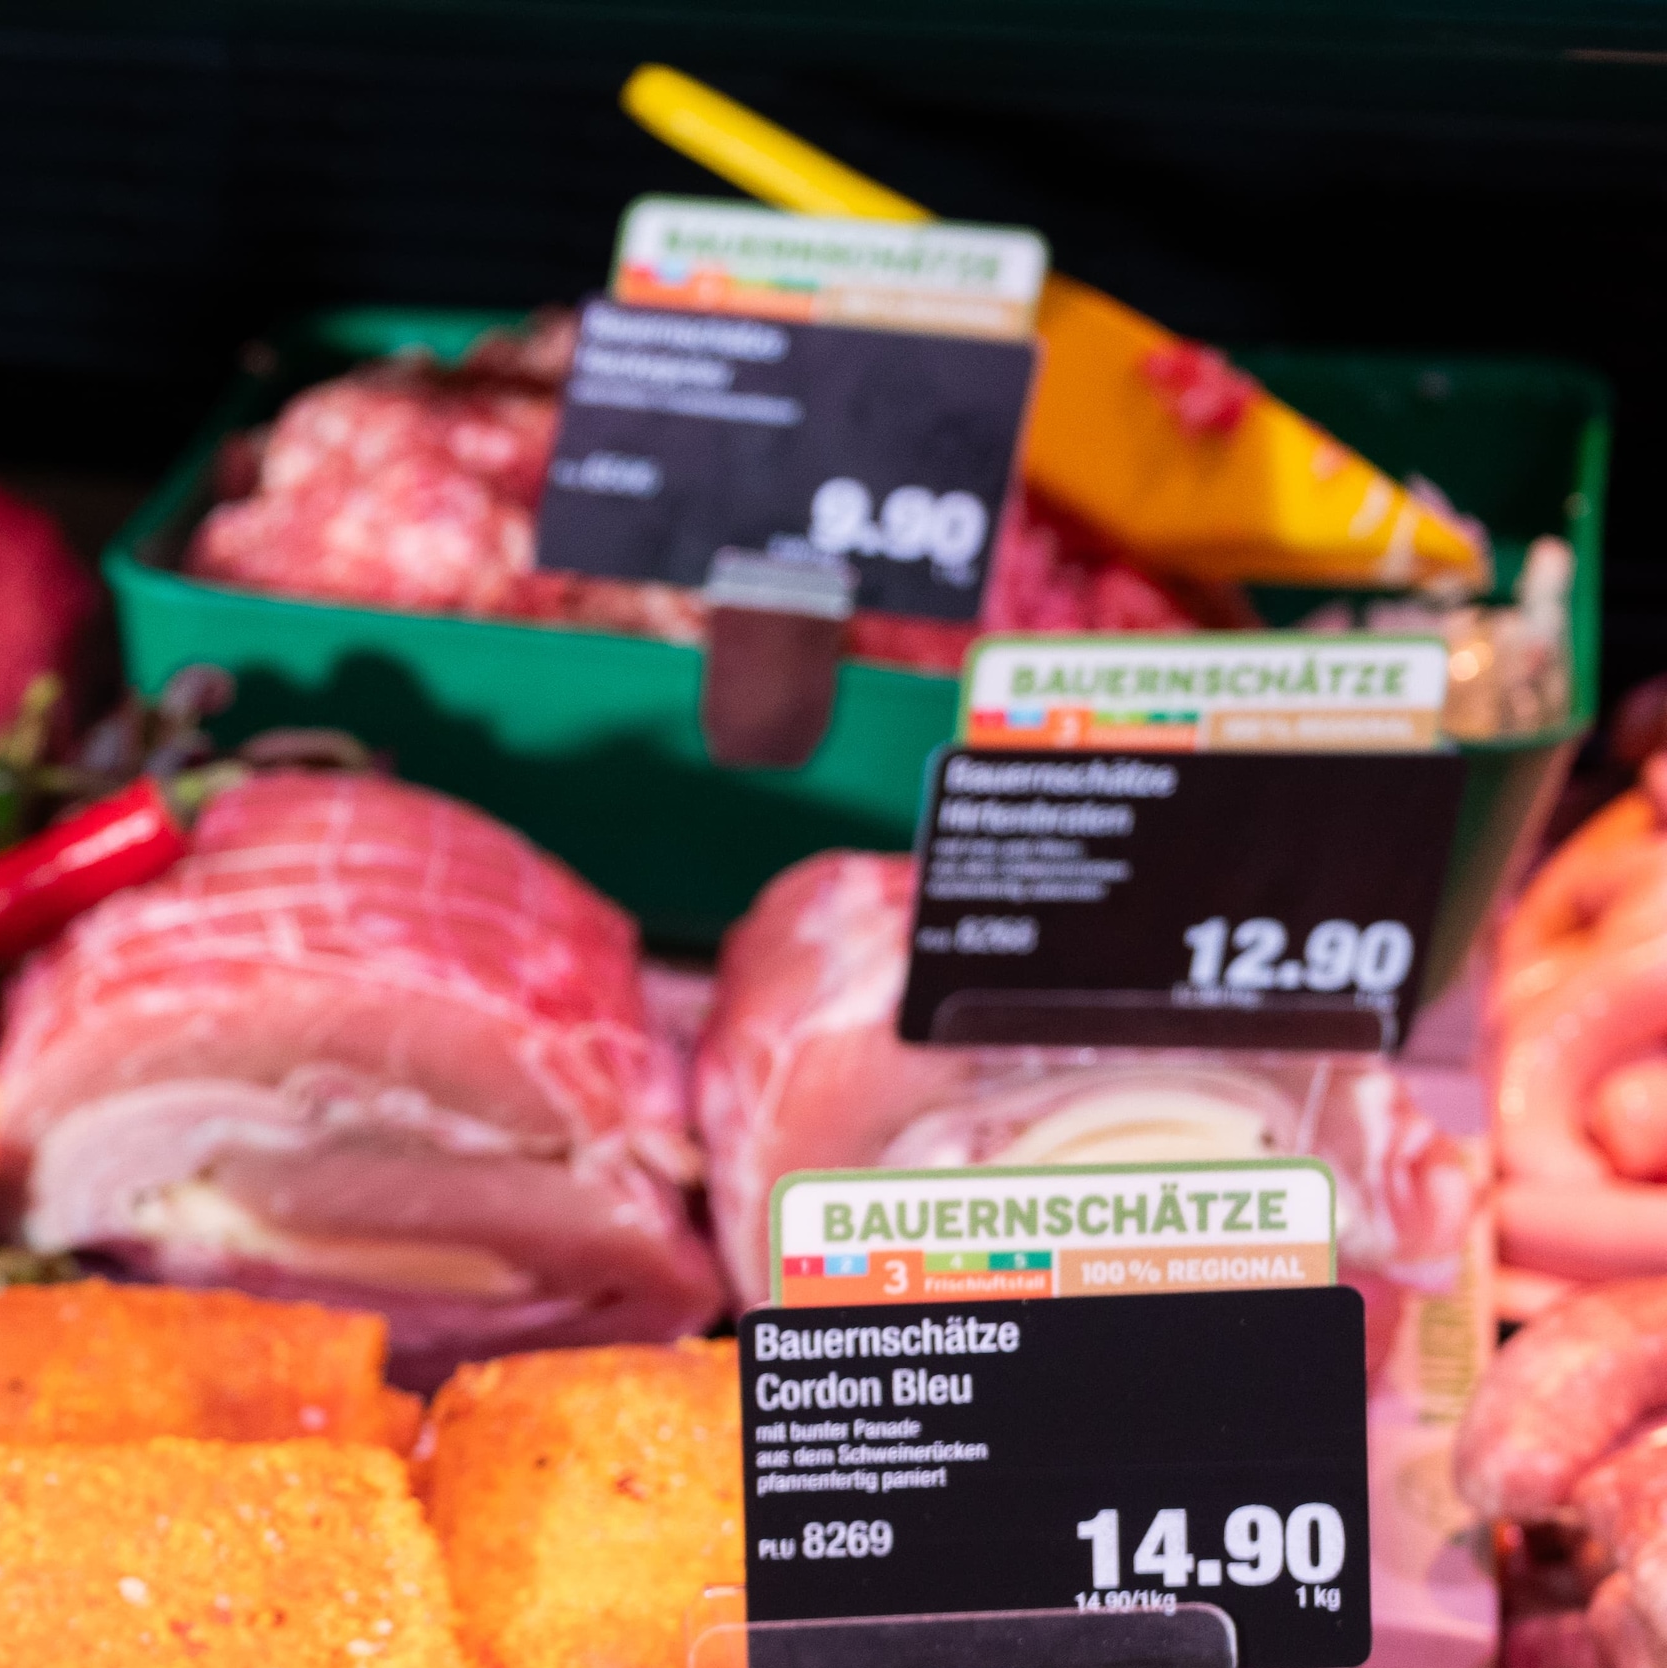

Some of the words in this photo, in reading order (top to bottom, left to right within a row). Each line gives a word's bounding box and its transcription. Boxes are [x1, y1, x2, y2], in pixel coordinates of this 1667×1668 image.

[810, 477, 987, 565] 9.90
[1010, 656, 1407, 697] BAUERNSCHÄTZE
[1183, 915, 1414, 991] 12.90
[823, 1183, 1288, 1243] BAUERNSCHÄTZE
[883, 1260, 909, 1294] 3
[1082, 1260, 1125, 1285] 100
[1129, 1258, 1162, 1284] %
[1168, 1255, 1305, 1283] REGIONAL
[755, 1316, 1020, 1361] Bauernschätze
[755, 1371, 883, 1411] Cordon
[892, 1367, 973, 1406] Bleu
[755, 1421, 787, 1443] mit
[789, 1420, 849, 1442] bunter
[853, 1417, 922, 1439] Panade
[756, 1449, 790, 1468] aus
[793, 1446, 835, 1467] dem
[837, 1440, 989, 1465] Schweinerücken
[881, 1466, 947, 1493] paniert
[758, 1538, 796, 1559] PLU
[802, 1519, 893, 1559] 8269
[1076, 1502, 1345, 1589] 14.90
[1296, 1585, 1307, 1608] 1
[1314, 1585, 1341, 1612] kg
